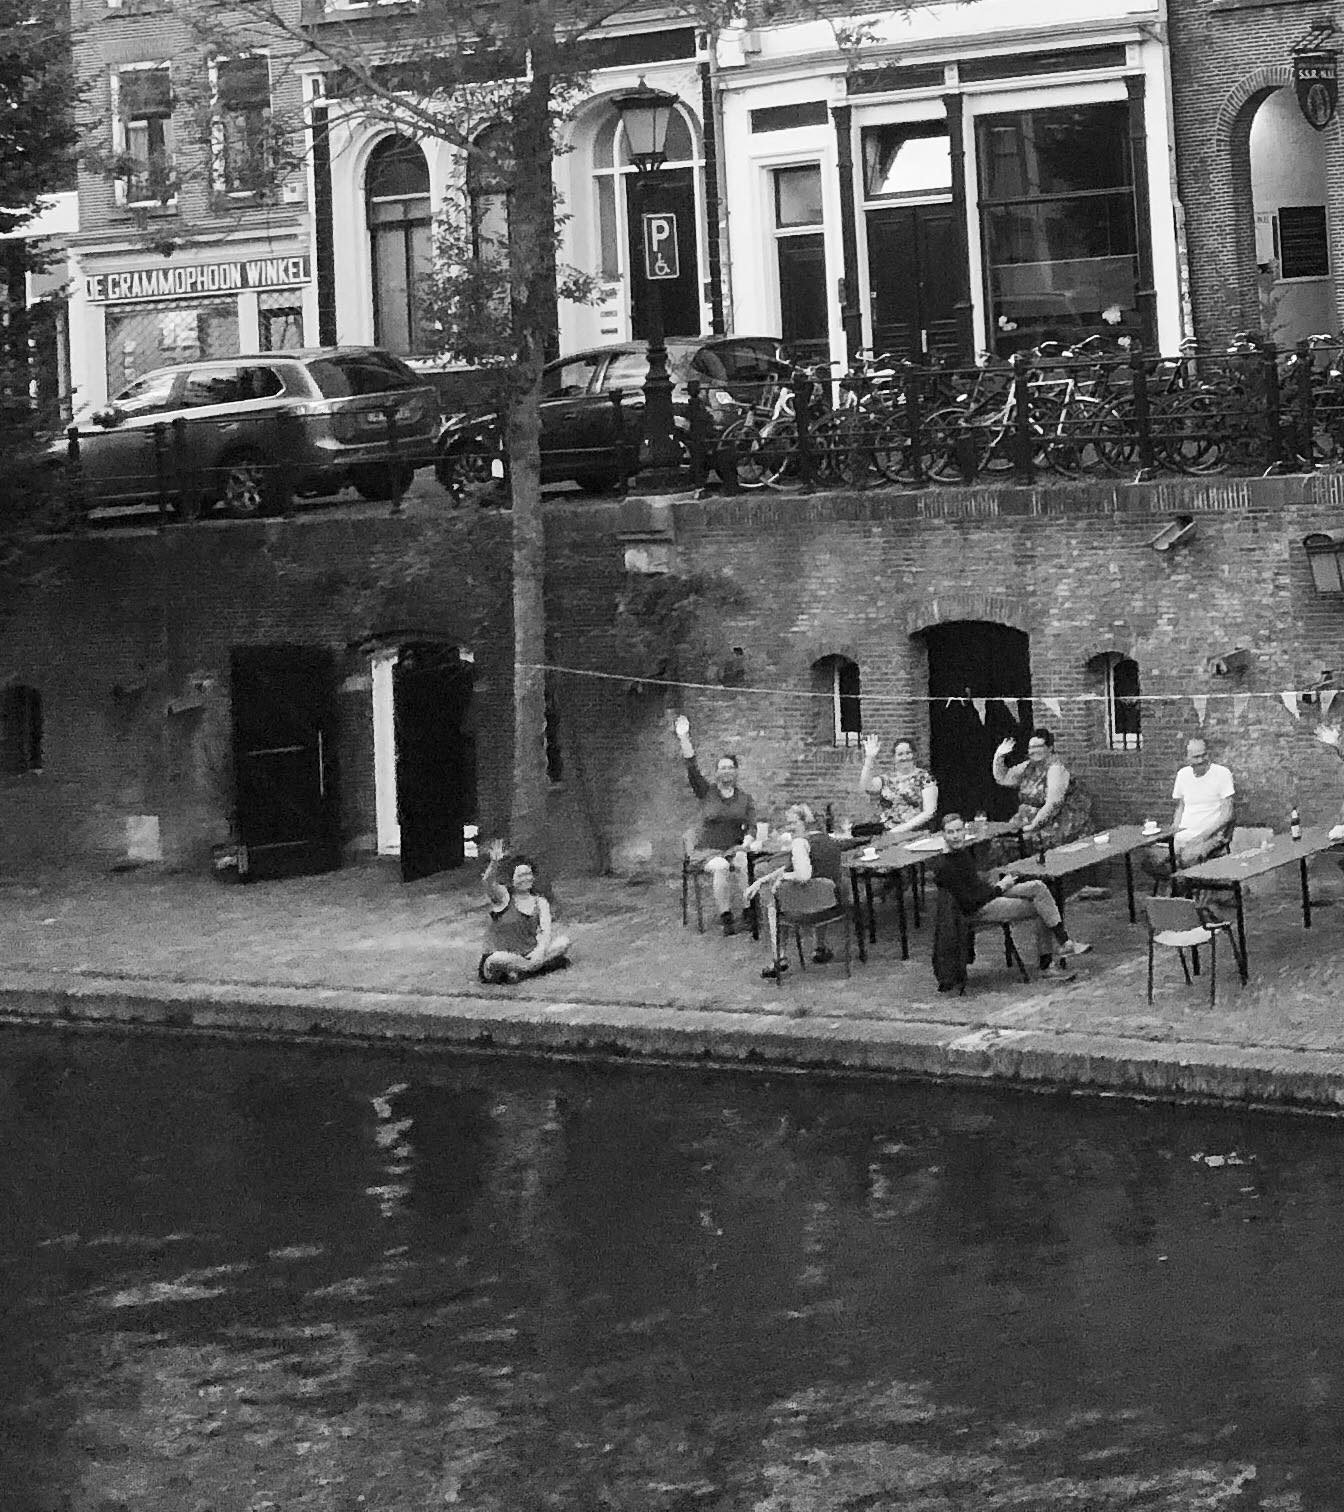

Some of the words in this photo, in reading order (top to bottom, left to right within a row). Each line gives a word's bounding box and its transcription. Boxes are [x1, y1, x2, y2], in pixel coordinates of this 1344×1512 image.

[651, 219, 670, 252] P
[85, 275, 104, 301] DE
[108, 262, 242, 301] GRAMMOPHOON
[246, 257, 312, 287] WINKEL
